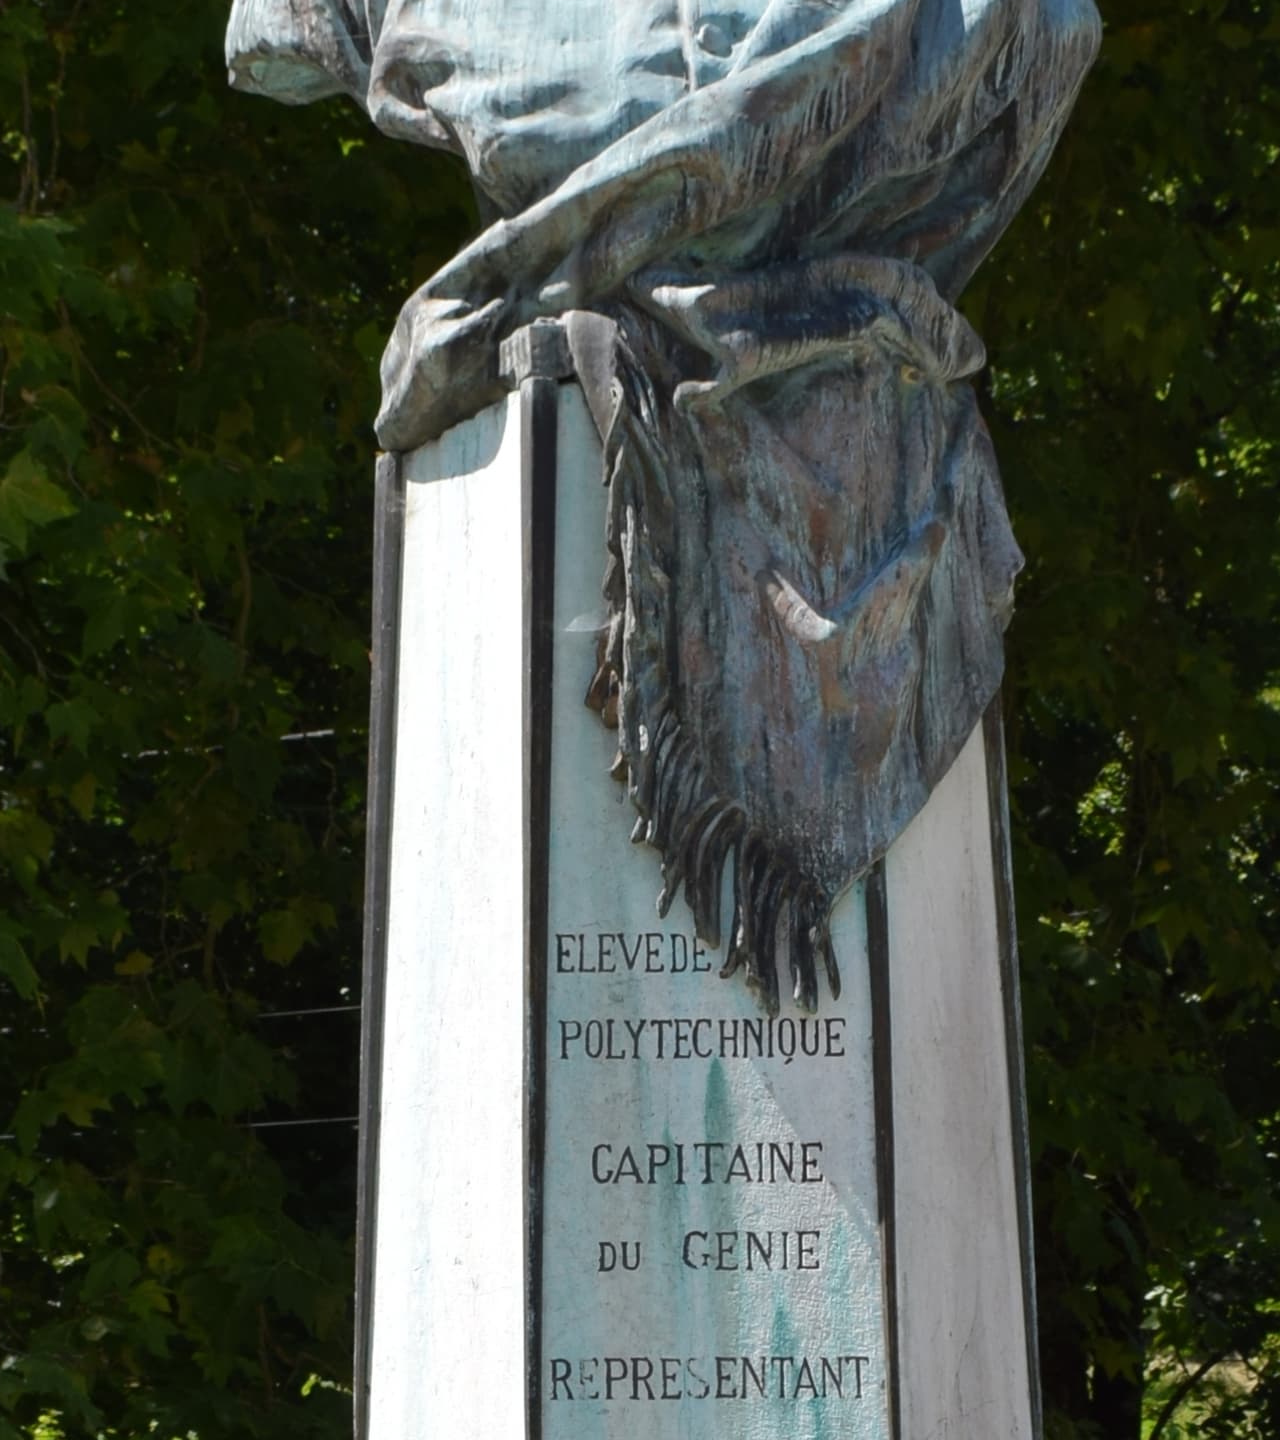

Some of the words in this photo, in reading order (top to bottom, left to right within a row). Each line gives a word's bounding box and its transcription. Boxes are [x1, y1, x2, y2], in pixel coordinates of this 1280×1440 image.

[559, 1017, 847, 1065] POLYTECHNIQUE
[590, 1141, 825, 1185] CAPITAINE
[597, 1240, 642, 1273] DU
[681, 1230, 822, 1271] GENIE
[549, 1355, 870, 1401] REPRESENTANT
